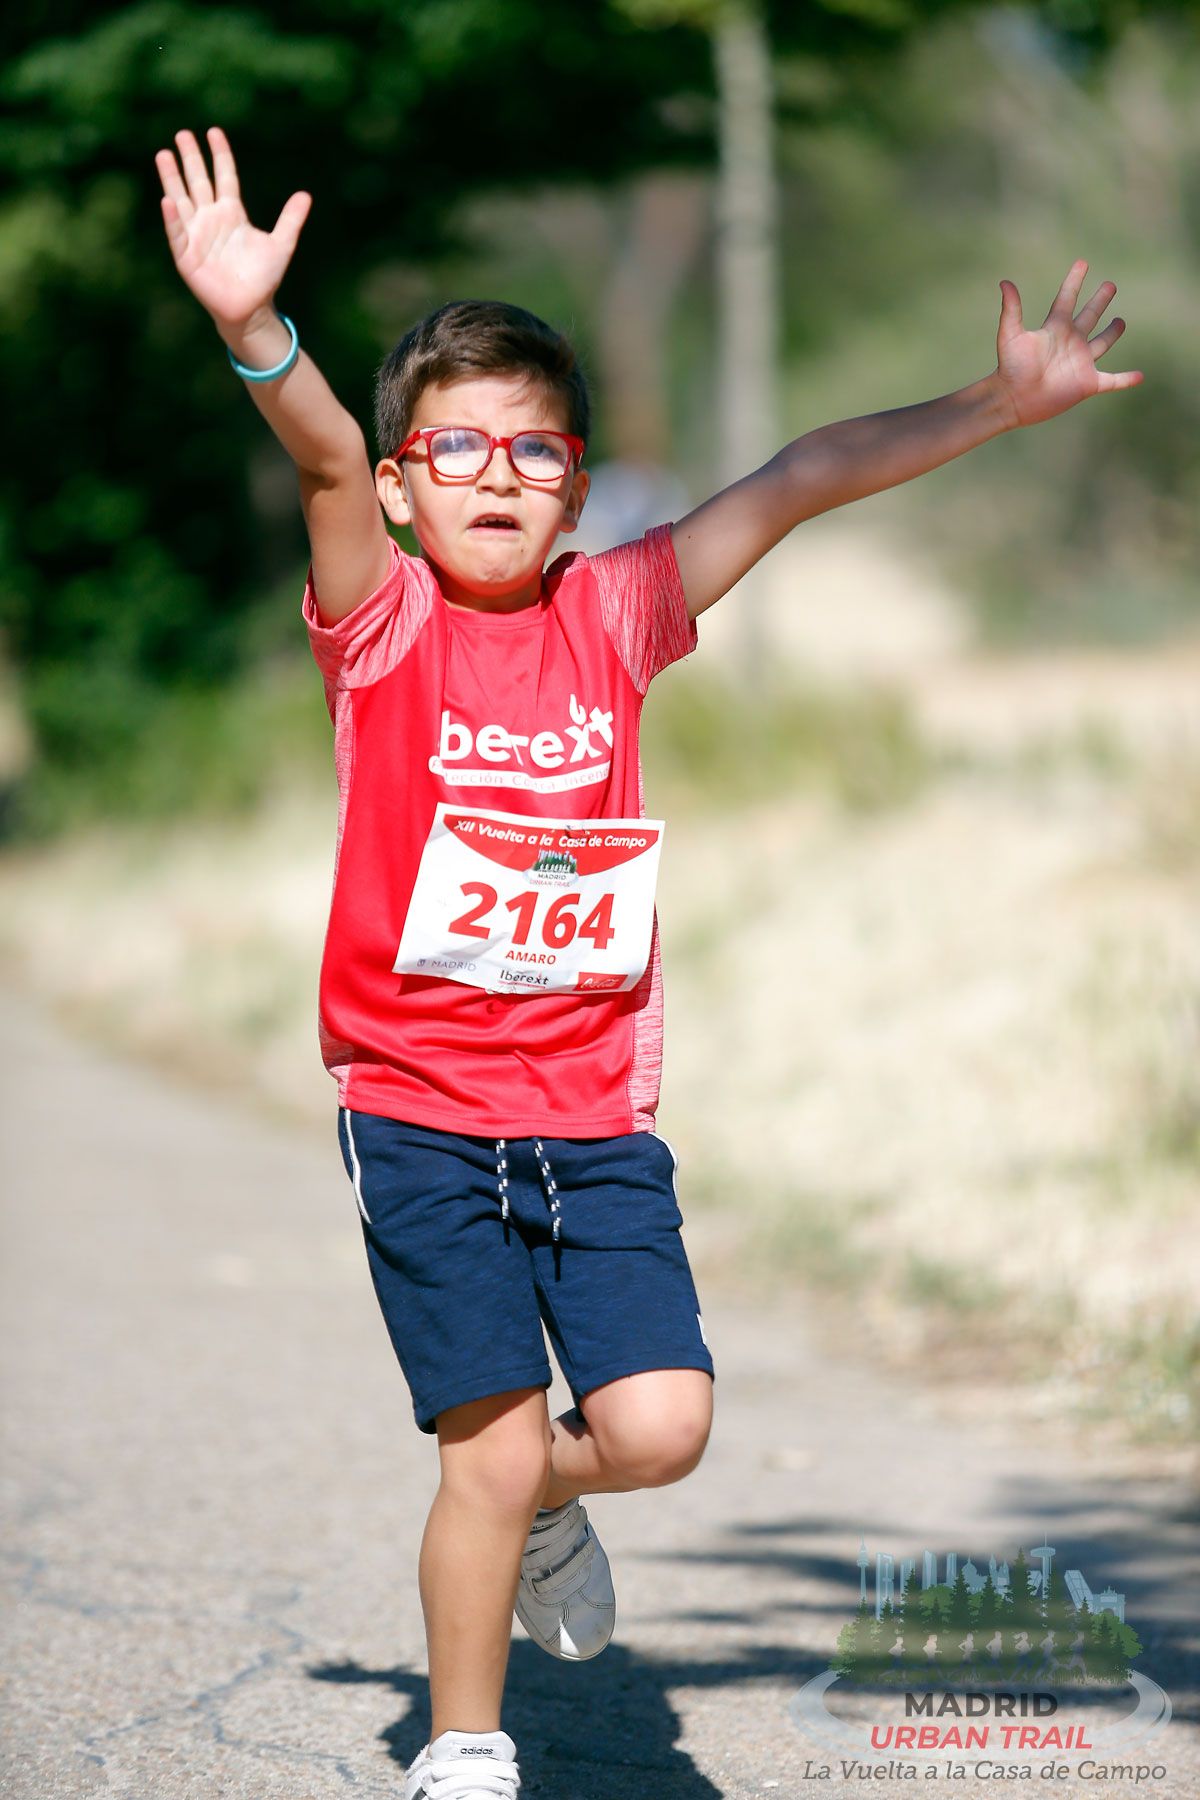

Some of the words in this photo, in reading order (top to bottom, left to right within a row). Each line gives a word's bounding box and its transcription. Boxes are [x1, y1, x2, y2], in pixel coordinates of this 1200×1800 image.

[437, 694, 614, 769] berext
[454, 820, 474, 833] XII
[477, 823, 524, 844] Vuelta
[527, 837, 536, 846] a
[540, 834, 553, 847] la
[558, 836, 587, 848] Casa
[588, 836, 602, 847] de
[604, 835, 647, 849] Campo
[448, 881, 615, 950] 2164
[431, 960, 476, 972] MADRID
[505, 950, 557, 965] AMARO
[500, 969, 549, 986] Iberext
[460, 1746, 494, 1755] adidas
